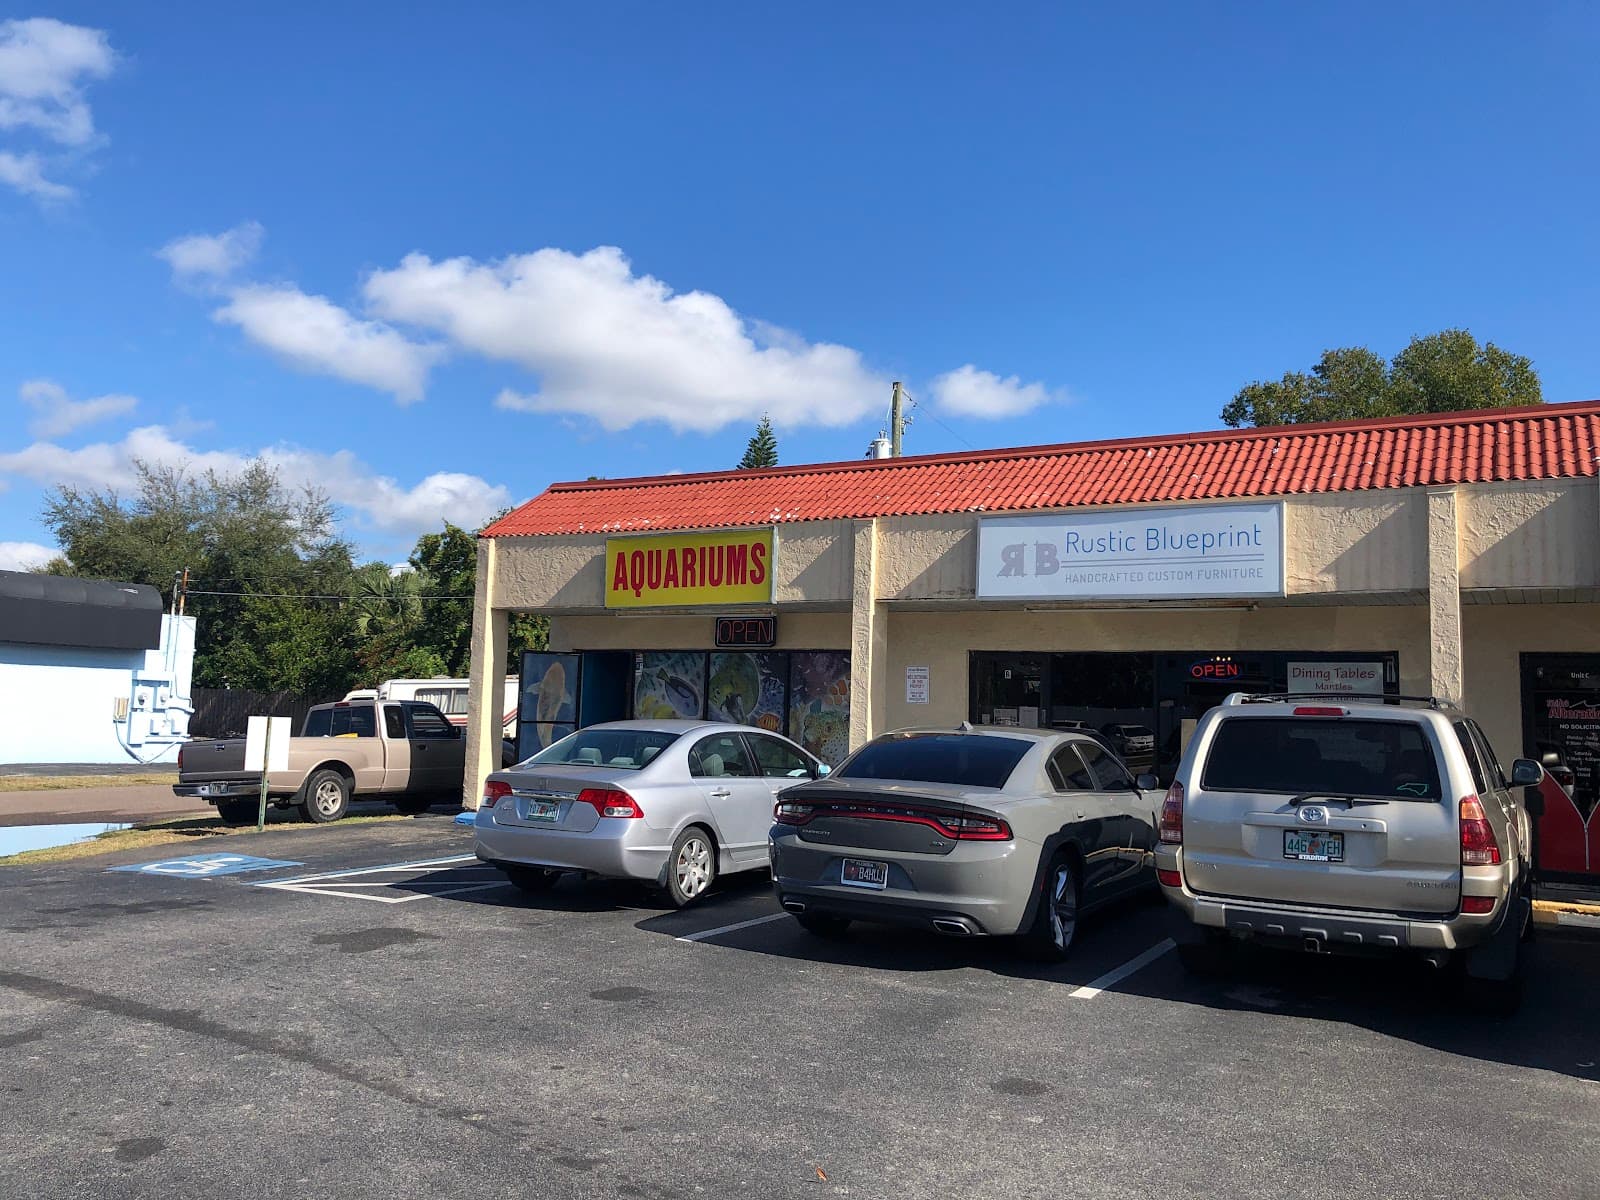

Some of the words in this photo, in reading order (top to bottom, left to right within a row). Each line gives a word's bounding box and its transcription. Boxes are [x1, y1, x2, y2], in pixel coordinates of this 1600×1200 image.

[1066, 530, 1136, 554] Rustic
[1146, 524, 1262, 555] Blueprint
[613, 542, 766, 598] AQUARIUMS
[1064, 572, 1144, 584] HANDCRAFTED
[1147, 570, 1193, 582] CUSTOM
[1197, 566, 1263, 580] FURNITURE
[719, 620, 771, 643] OPEN
[1191, 664, 1238, 677] OPEN
[1292, 667, 1331, 681] Dining
[1333, 667, 1376, 679] Tables
[1315, 682, 1353, 691] Mantles
[1287, 839, 1307, 853] 446
[1320, 839, 1340, 855] YEH
